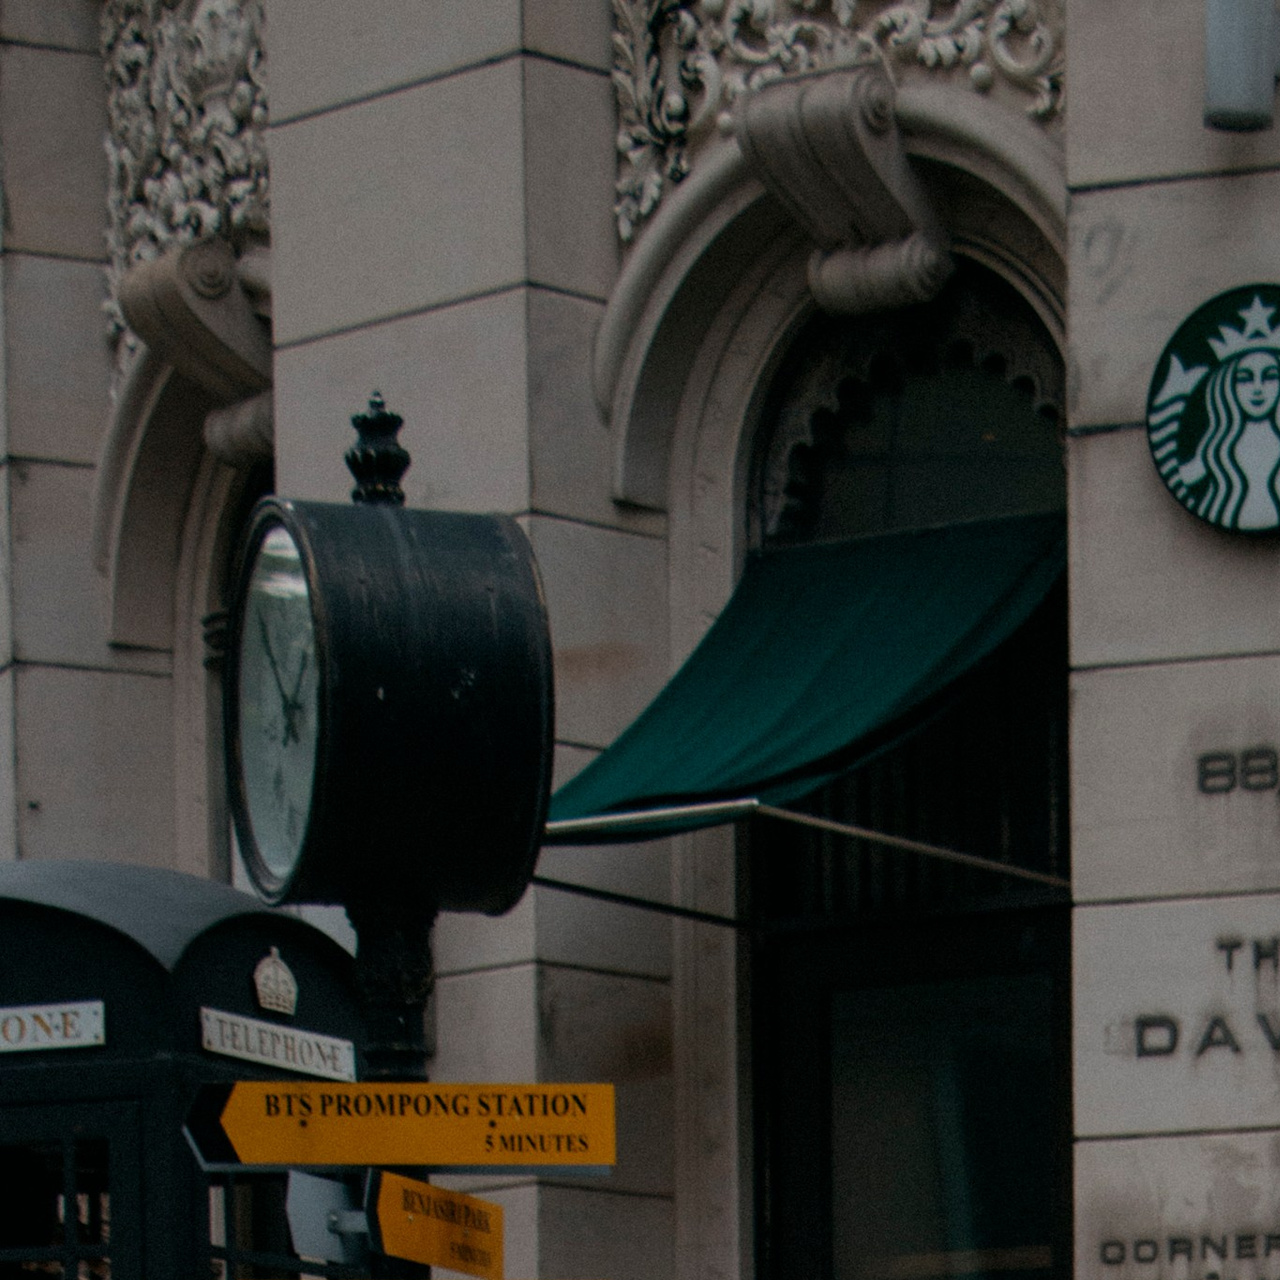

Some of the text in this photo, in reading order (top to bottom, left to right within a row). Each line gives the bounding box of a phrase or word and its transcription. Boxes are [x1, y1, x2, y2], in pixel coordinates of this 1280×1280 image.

[215, 1018, 343, 1072] TELEPHONE
[265, 1093, 588, 1117] BTS PROMPONG STATION
[485, 1134, 589, 1153] 5 MINUTES
